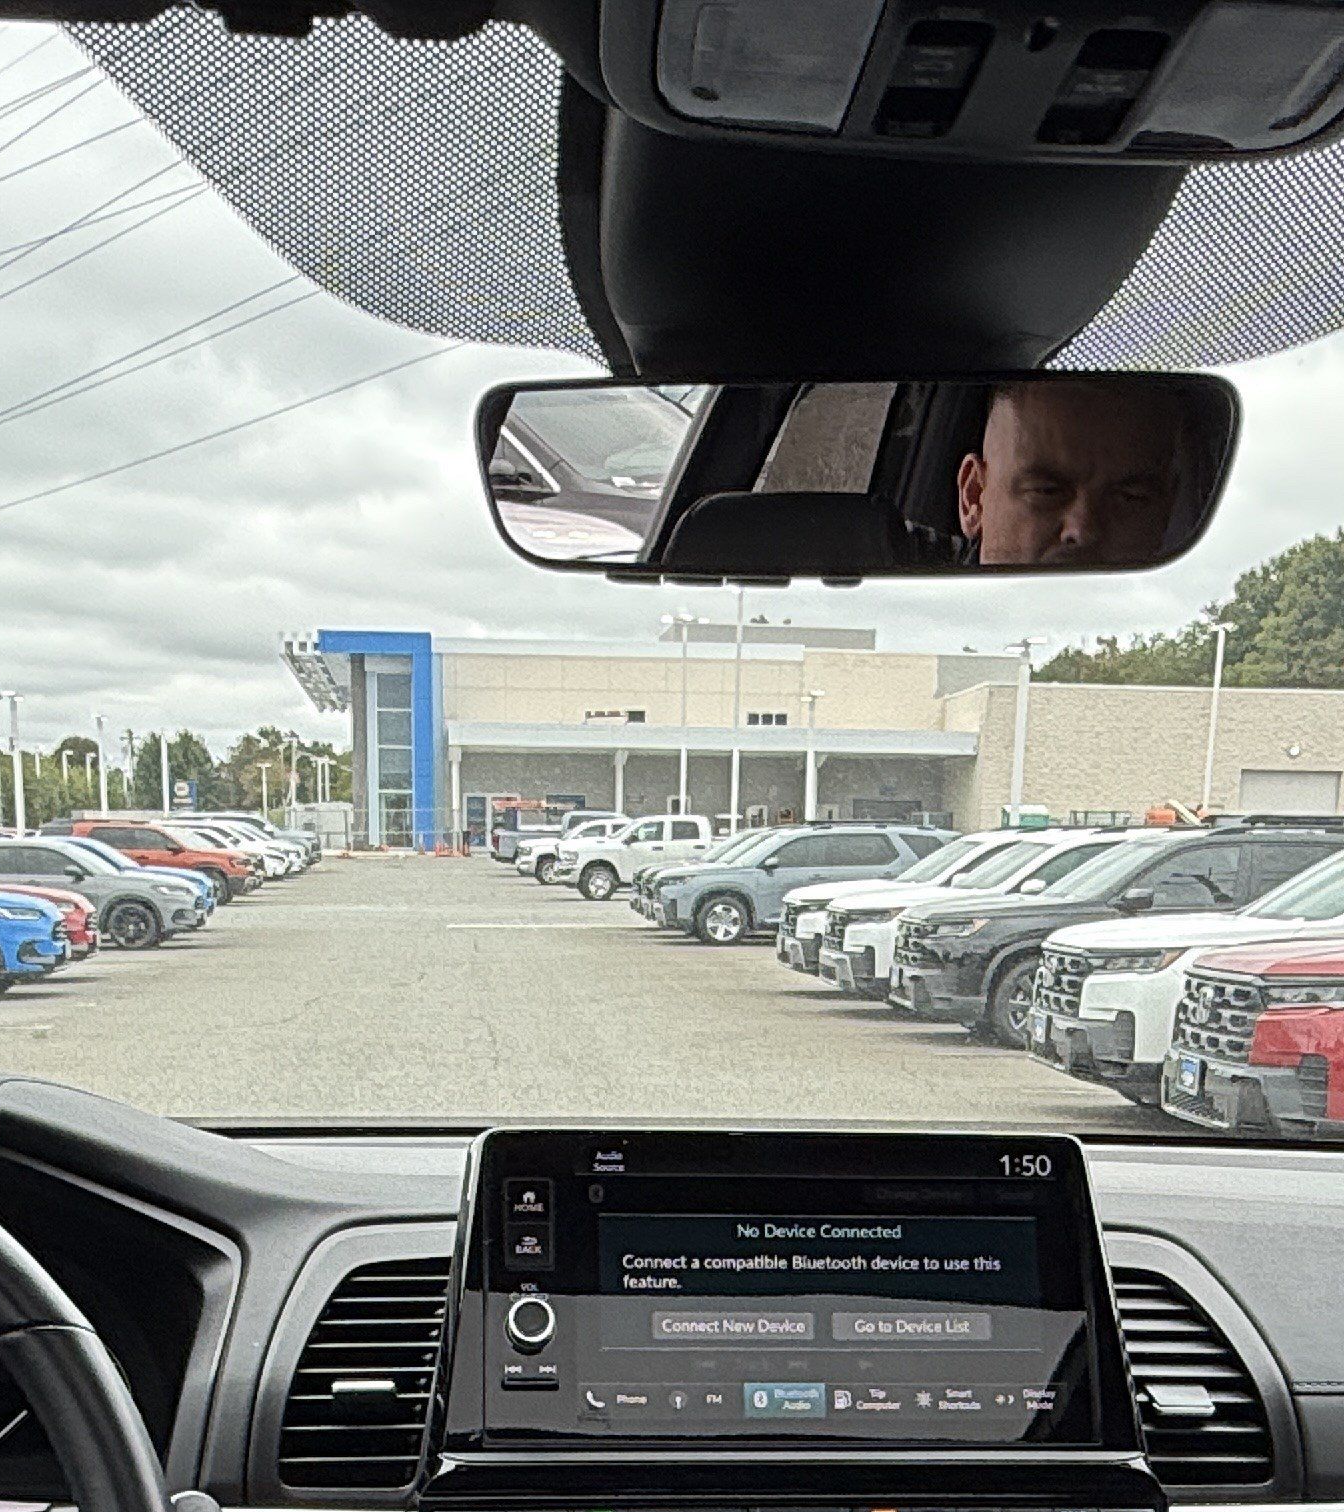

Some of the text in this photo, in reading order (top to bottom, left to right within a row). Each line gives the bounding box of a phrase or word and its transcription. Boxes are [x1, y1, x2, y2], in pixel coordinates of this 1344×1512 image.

[998, 1153, 1053, 1177] 1:50
[736, 1222, 902, 1240] No Device Connected
[622, 1253, 1002, 1273] Connect a compatible Bluetooth device to use this
[622, 1273, 683, 1290] feature.
[661, 1318, 807, 1334] Connect New Device
[854, 1318, 971, 1334] Go to Device List
